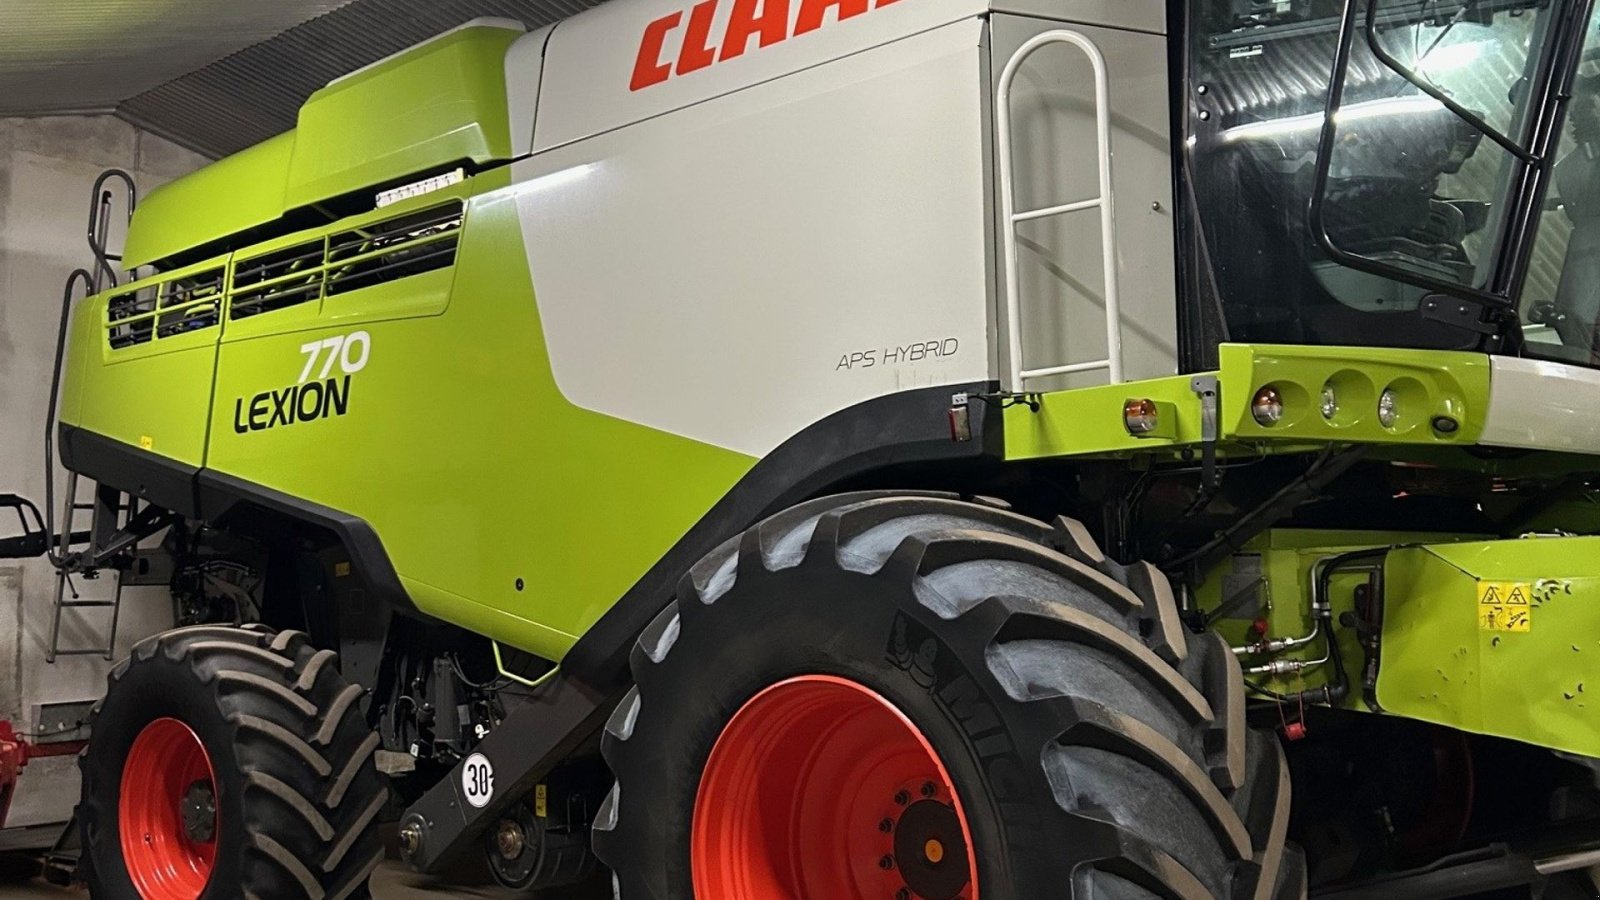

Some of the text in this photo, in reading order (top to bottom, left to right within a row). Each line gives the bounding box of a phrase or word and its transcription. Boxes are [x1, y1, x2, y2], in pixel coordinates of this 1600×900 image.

[298, 330, 371, 384] 770
[836, 338, 959, 371] APS HYBRID
[234, 374, 351, 434] LEXION
[468, 764, 488, 796] 30
